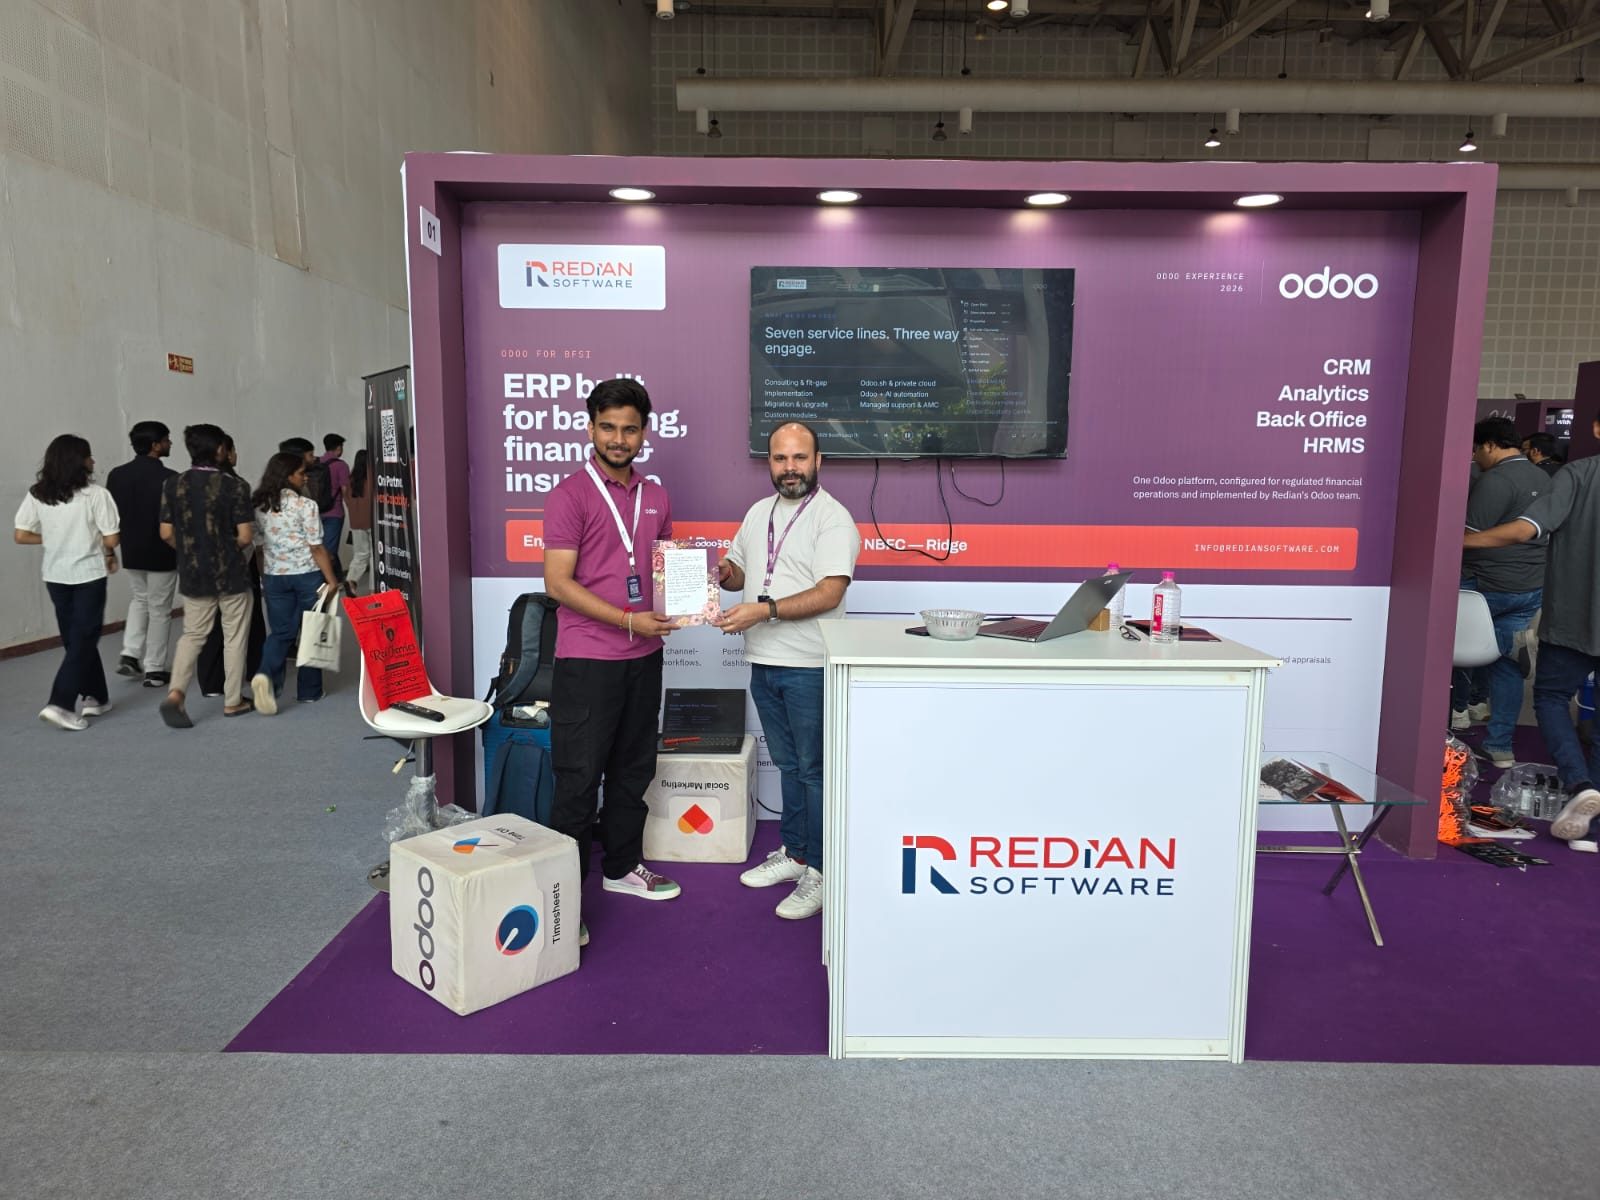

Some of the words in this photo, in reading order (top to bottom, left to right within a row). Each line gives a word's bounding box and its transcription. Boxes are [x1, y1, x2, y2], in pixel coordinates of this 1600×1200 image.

[427, 221, 437, 242] 01
[1156, 272, 1180, 280] ODOO
[1185, 272, 1245, 280] EXPERIENCE
[553, 278, 633, 288] SOFTWARE
[1278, 265, 1379, 299] odoo
[1219, 284, 1244, 292] 2026
[765, 326, 804, 339] Seven
[807, 326, 854, 339] service
[857, 327, 890, 340] lines.
[893, 327, 930, 341] Three
[932, 330, 960, 344] way
[501, 350, 528, 358] ODOO
[536, 350, 556, 358] FOR
[564, 350, 593, 359] BFSI
[765, 344, 816, 357] engage.
[1323, 358, 1371, 376] CRM
[503, 373, 572, 399] ERP
[764, 379, 799, 387] Consulting
[805, 379, 828, 388] fit-gap
[860, 379, 887, 387] Odoo.sh
[894, 380, 917, 388] private
[764, 390, 813, 399] Implementation
[860, 390, 878, 398] Odoo
[1277, 384, 1370, 405] Analytics
[764, 401, 796, 409] Migration
[801, 402, 829, 410] upgrade
[860, 401, 890, 410] Managed
[890, 402, 917, 410] support
[503, 404, 548, 430] for
[790, 412, 818, 420] modules
[1256, 411, 1306, 427] Back
[1309, 410, 1368, 427] Office
[1303, 437, 1366, 453] HRMS
[1132, 476, 1151, 485] One
[1153, 476, 1176, 485] Odoo
[1177, 476, 1218, 487] platform,
[1219, 476, 1266, 487] configured
[1267, 477, 1280, 486] for
[1282, 477, 1323, 488] regulated
[1325, 477, 1362, 487] financial
[1133, 490, 1180, 501] operations
[1181, 490, 1198, 499] and
[1199, 490, 1257, 501] implemented
[1259, 490, 1270, 501] by
[1272, 490, 1309, 500] Redian's
[1310, 491, 1334, 500] Odoo
[1336, 491, 1361, 500] team.
[864, 538, 906, 551] NBFC
[926, 538, 968, 554] Ridge
[1194, 543, 1340, 553] INFO@REDIANSOFTWARE.COM
[665, 647, 700, 656] channel-
[1291, 656, 1332, 665] appraisals
[661, 779, 703, 790] Marketing
[704, 781, 730, 790] Social
[969, 876, 1175, 895] SOFTWARE
[552, 881, 561, 945] Timesheets
[413, 866, 436, 992] odoo
